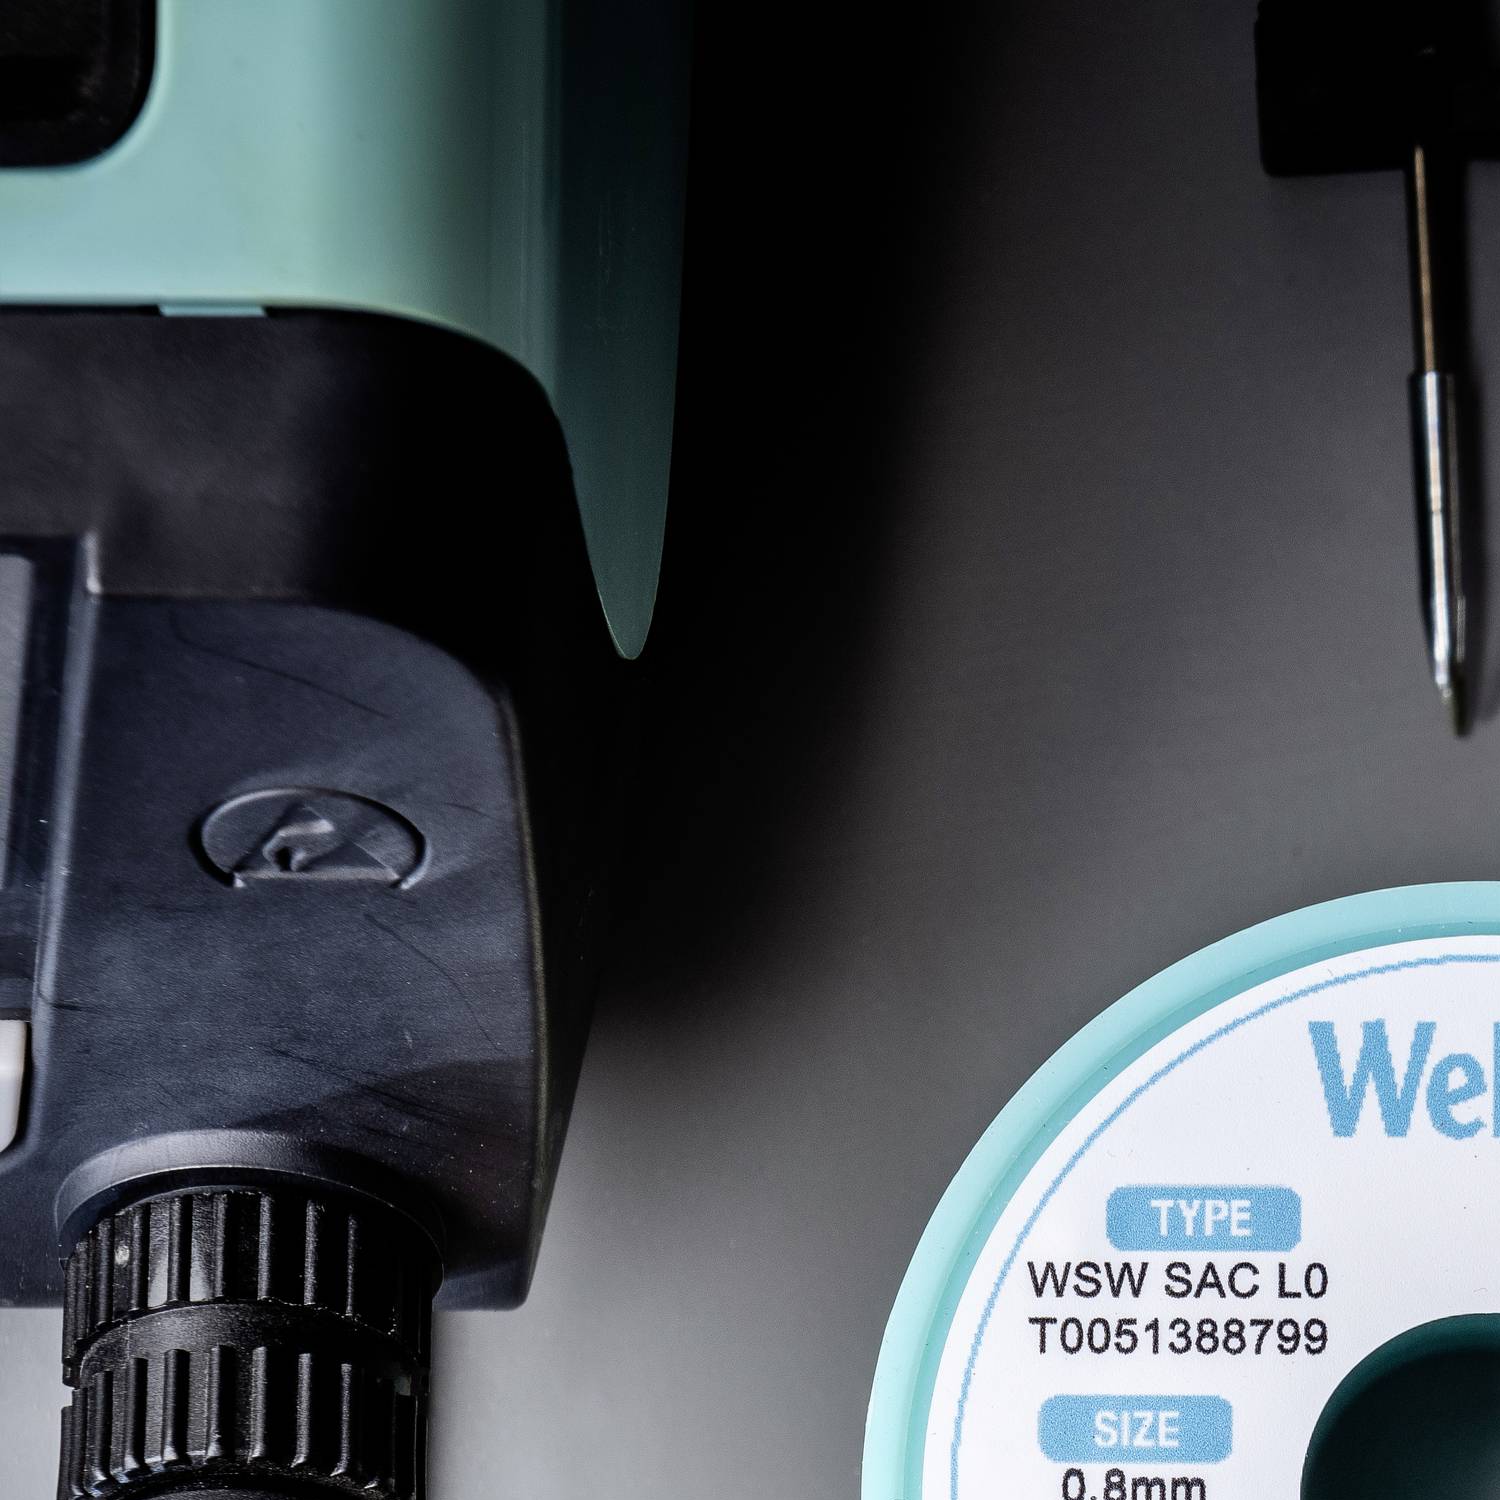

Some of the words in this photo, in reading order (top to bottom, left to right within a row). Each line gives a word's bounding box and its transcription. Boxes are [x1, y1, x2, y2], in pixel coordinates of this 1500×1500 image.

[1151, 1199, 1251, 1237] TYPE
[1027, 1261, 1149, 1298] WSW
[1164, 1261, 1260, 1299] SAC
[1028, 1316, 1328, 1356] T0051388799
[1093, 1409, 1181, 1448] SIZE
